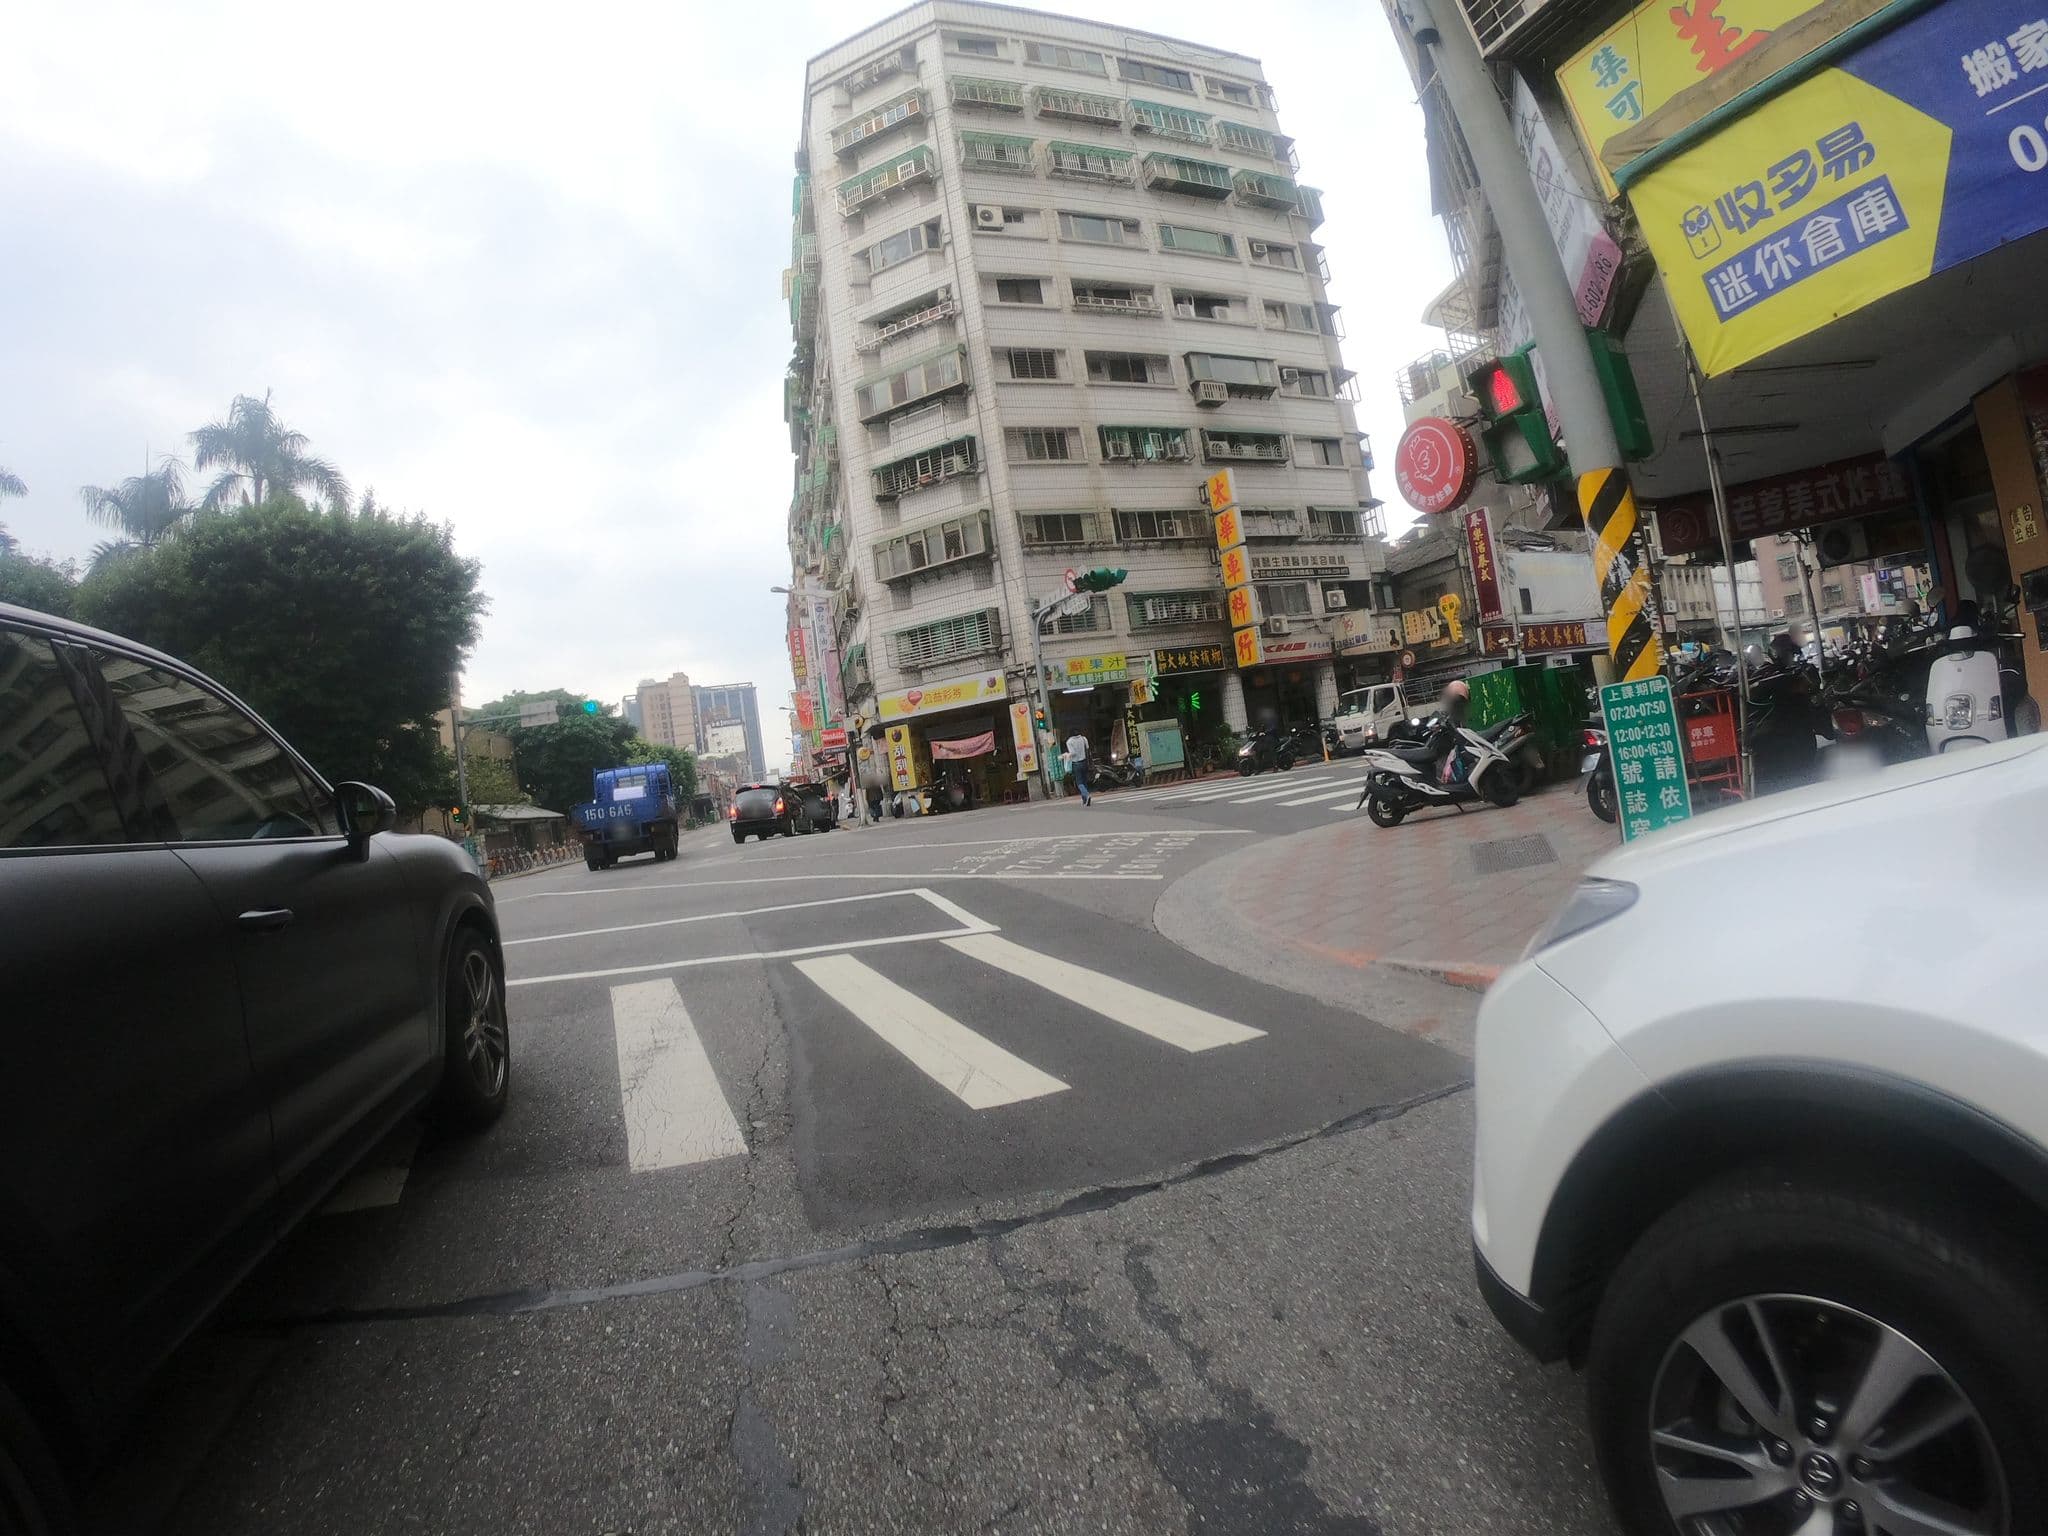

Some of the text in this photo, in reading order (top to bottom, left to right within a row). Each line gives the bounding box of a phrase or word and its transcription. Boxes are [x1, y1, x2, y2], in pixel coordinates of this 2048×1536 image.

[1961, 19, 2048, 98] 搬家
[2009, 115, 2048, 172] 0
[1717, 121, 1877, 236] 收多易
[1709, 186, 1899, 318] 迷你倉庫
[1608, 680, 1666, 702] 上課期間
[1610, 699, 1667, 722] 07:20-07:50
[1613, 722, 1671, 743] 12:00-12:30
[1690, 725, 1715, 740] 停車
[1618, 740, 1675, 761] 16:00-16:30
